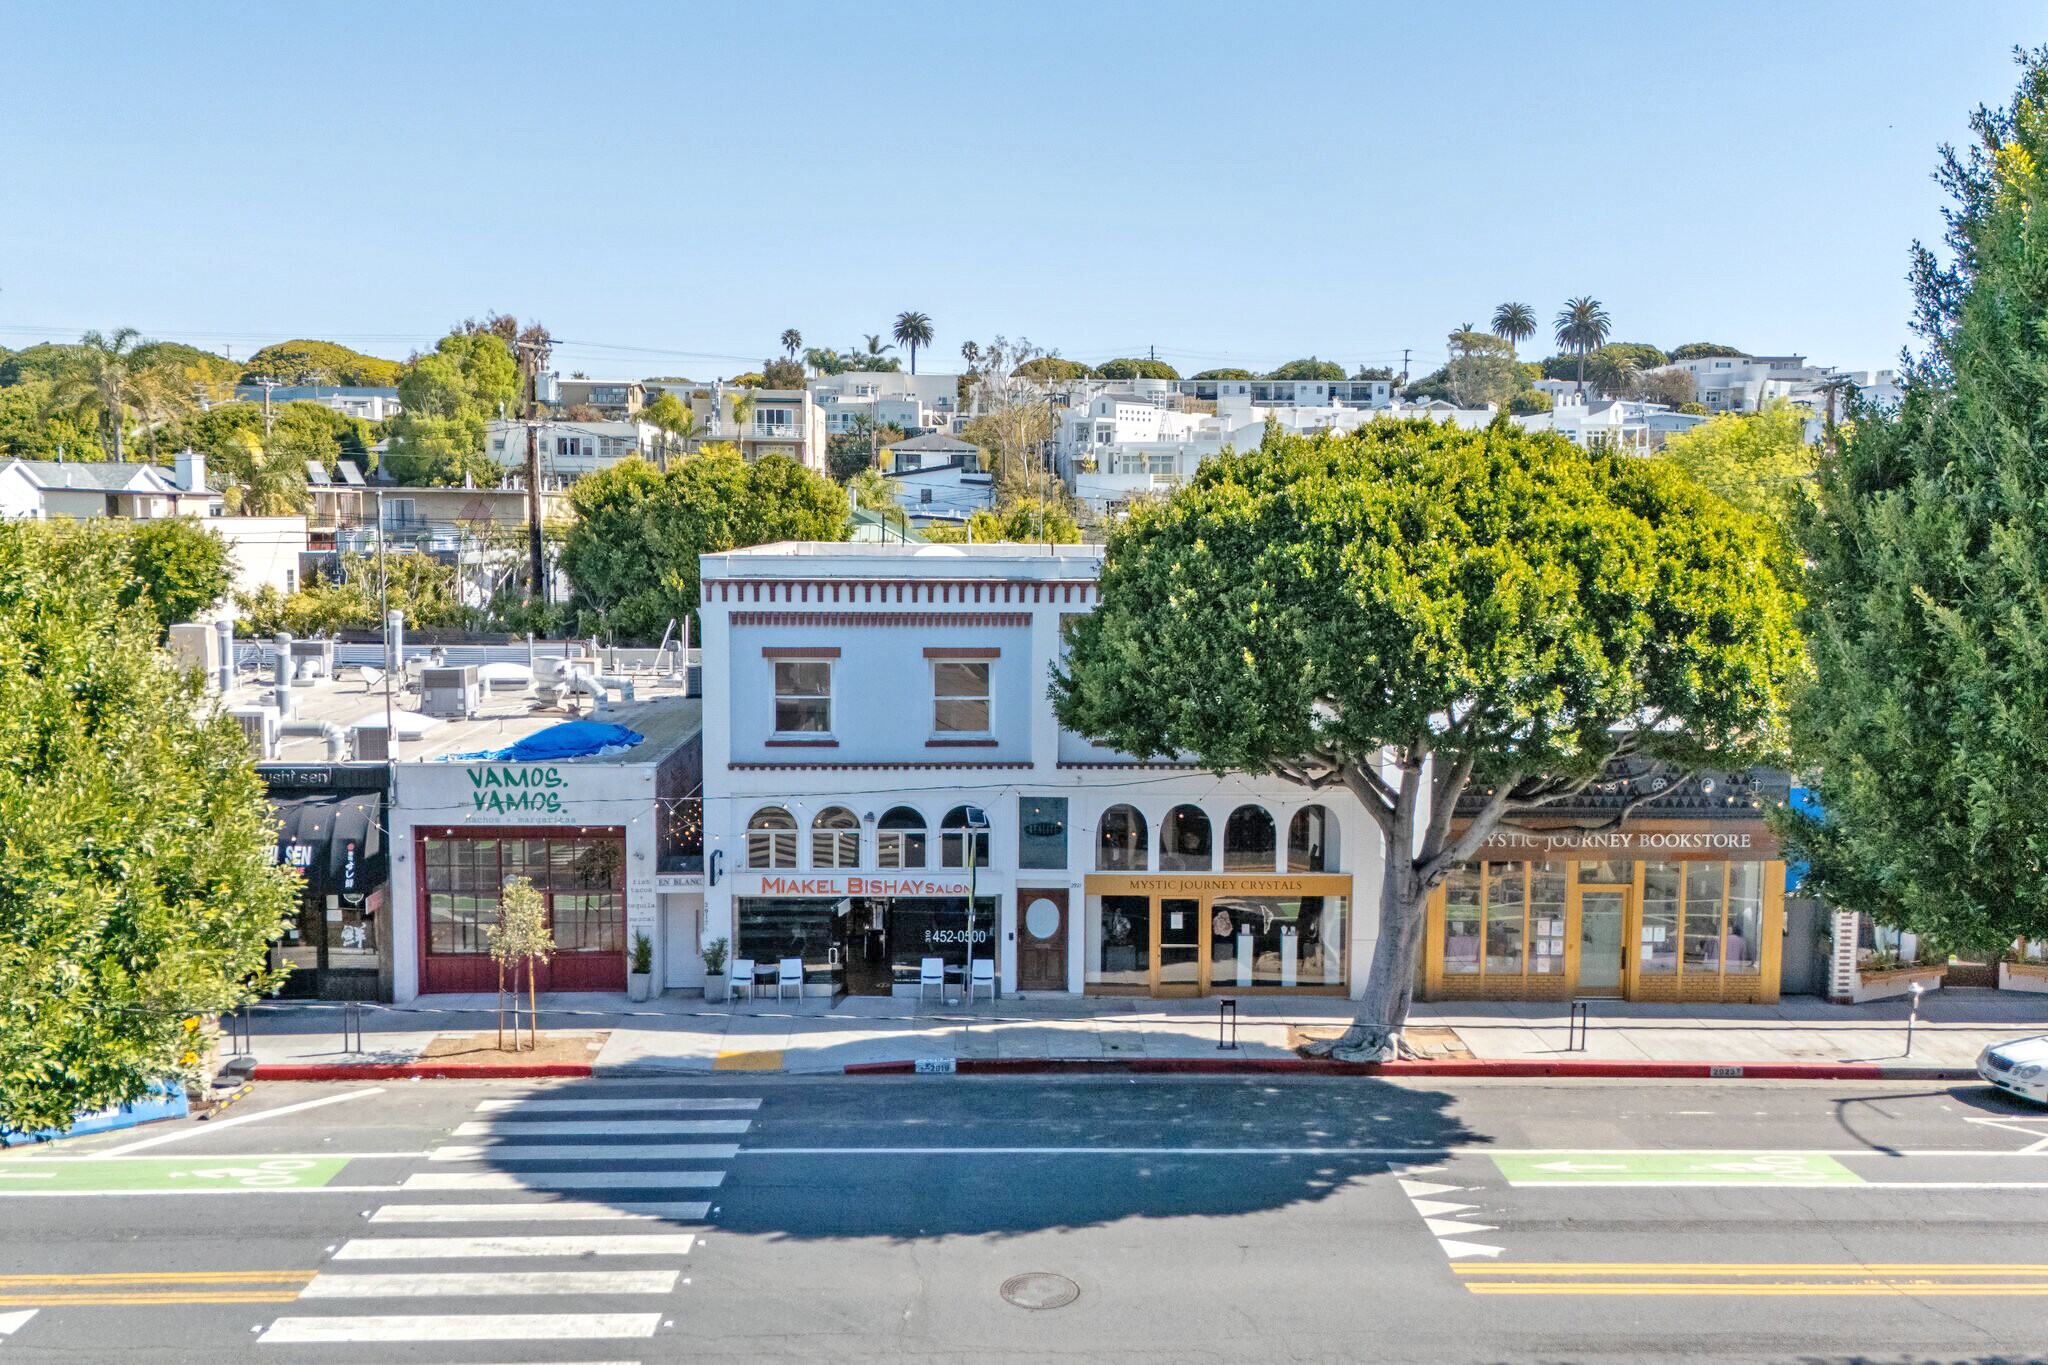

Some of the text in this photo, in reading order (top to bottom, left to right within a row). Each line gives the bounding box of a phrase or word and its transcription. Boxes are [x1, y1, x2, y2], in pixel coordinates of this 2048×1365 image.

[262, 769, 328, 784] ushi sen
[466, 766, 568, 788] VAMOS.
[473, 790, 568, 815] VAMOS.
[517, 817, 577, 826] margaritas
[1479, 832, 1751, 852] YSTIC JOURNEY BOOKSTORE
[285, 845, 312, 866] SEN
[658, 878, 669, 886] EN
[761, 876, 842, 895] MIAKEL
[847, 876, 925, 896] BISHAY
[1129, 880, 1303, 892] MYSTIC JOURNEY CRYSTALS
